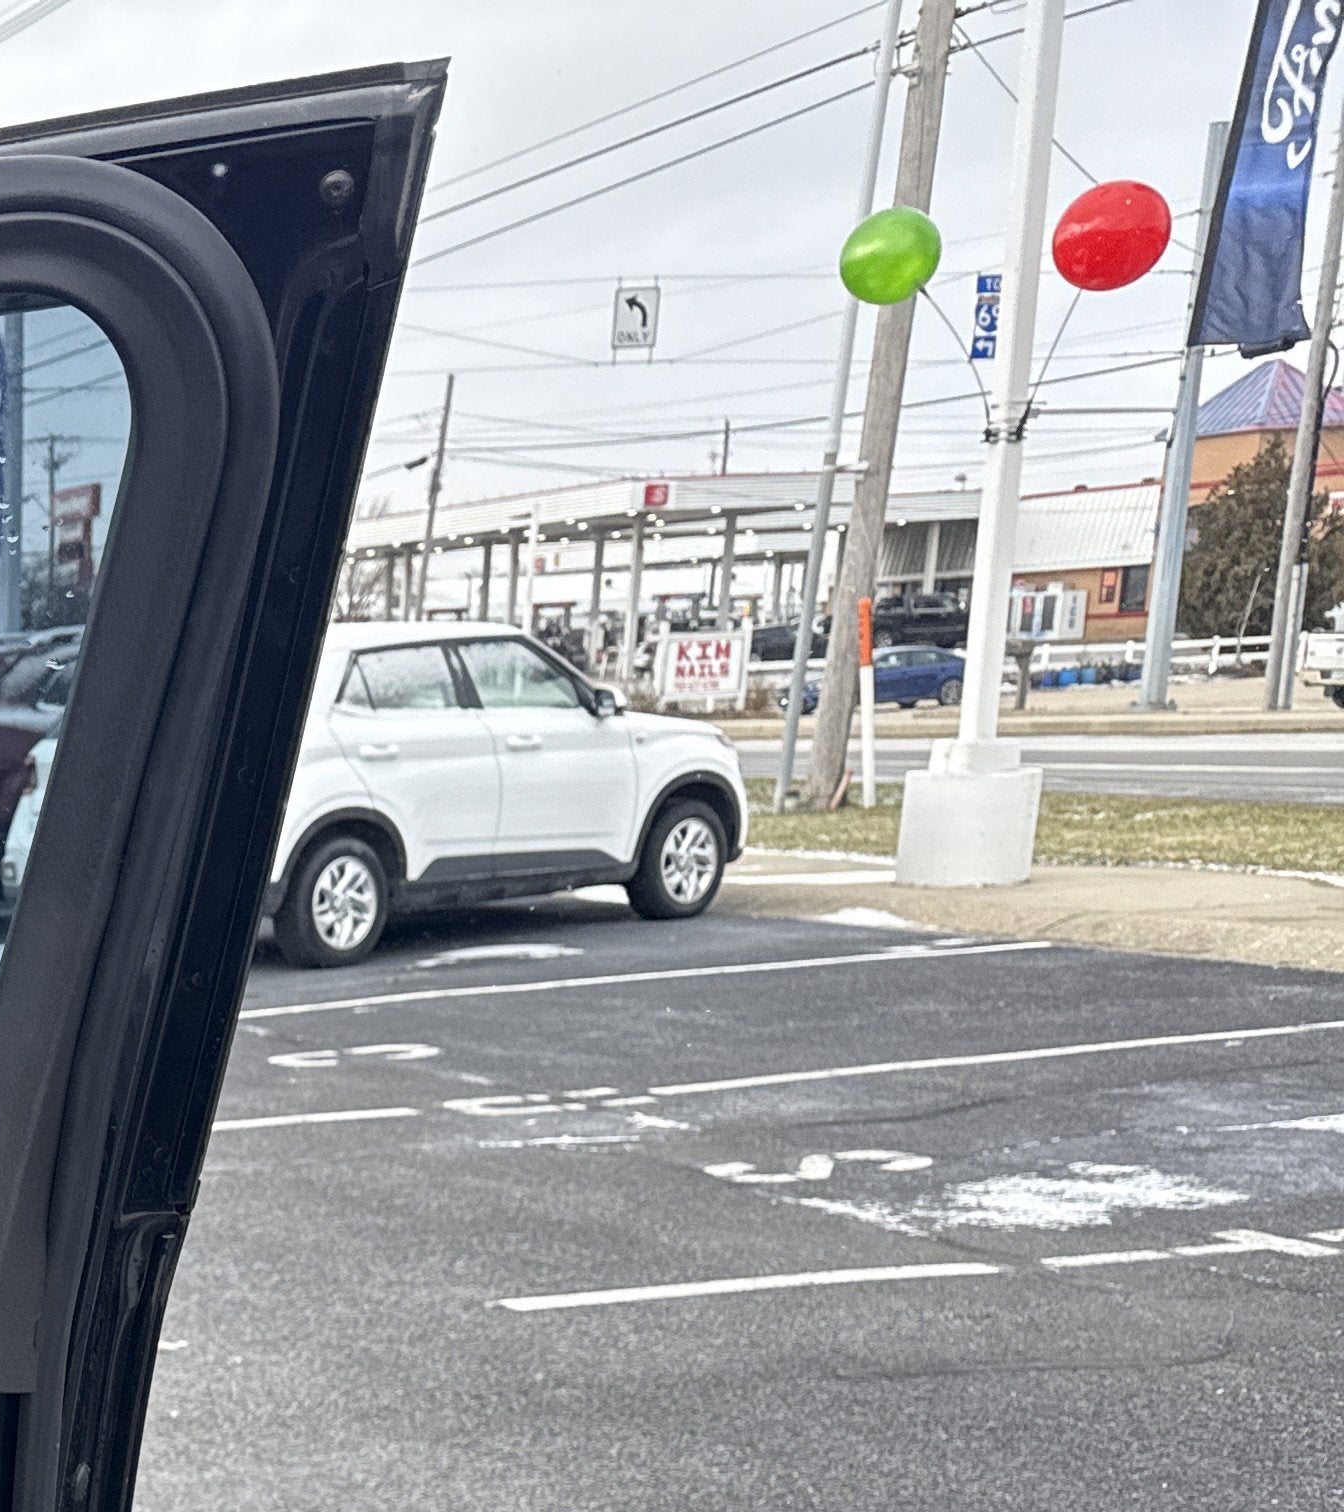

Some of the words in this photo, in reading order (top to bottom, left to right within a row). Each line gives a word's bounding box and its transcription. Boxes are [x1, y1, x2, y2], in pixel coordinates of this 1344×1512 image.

[616, 330, 651, 343] ONLY
[677, 640, 731, 661] KIM
[675, 662, 730, 677] NAILS
